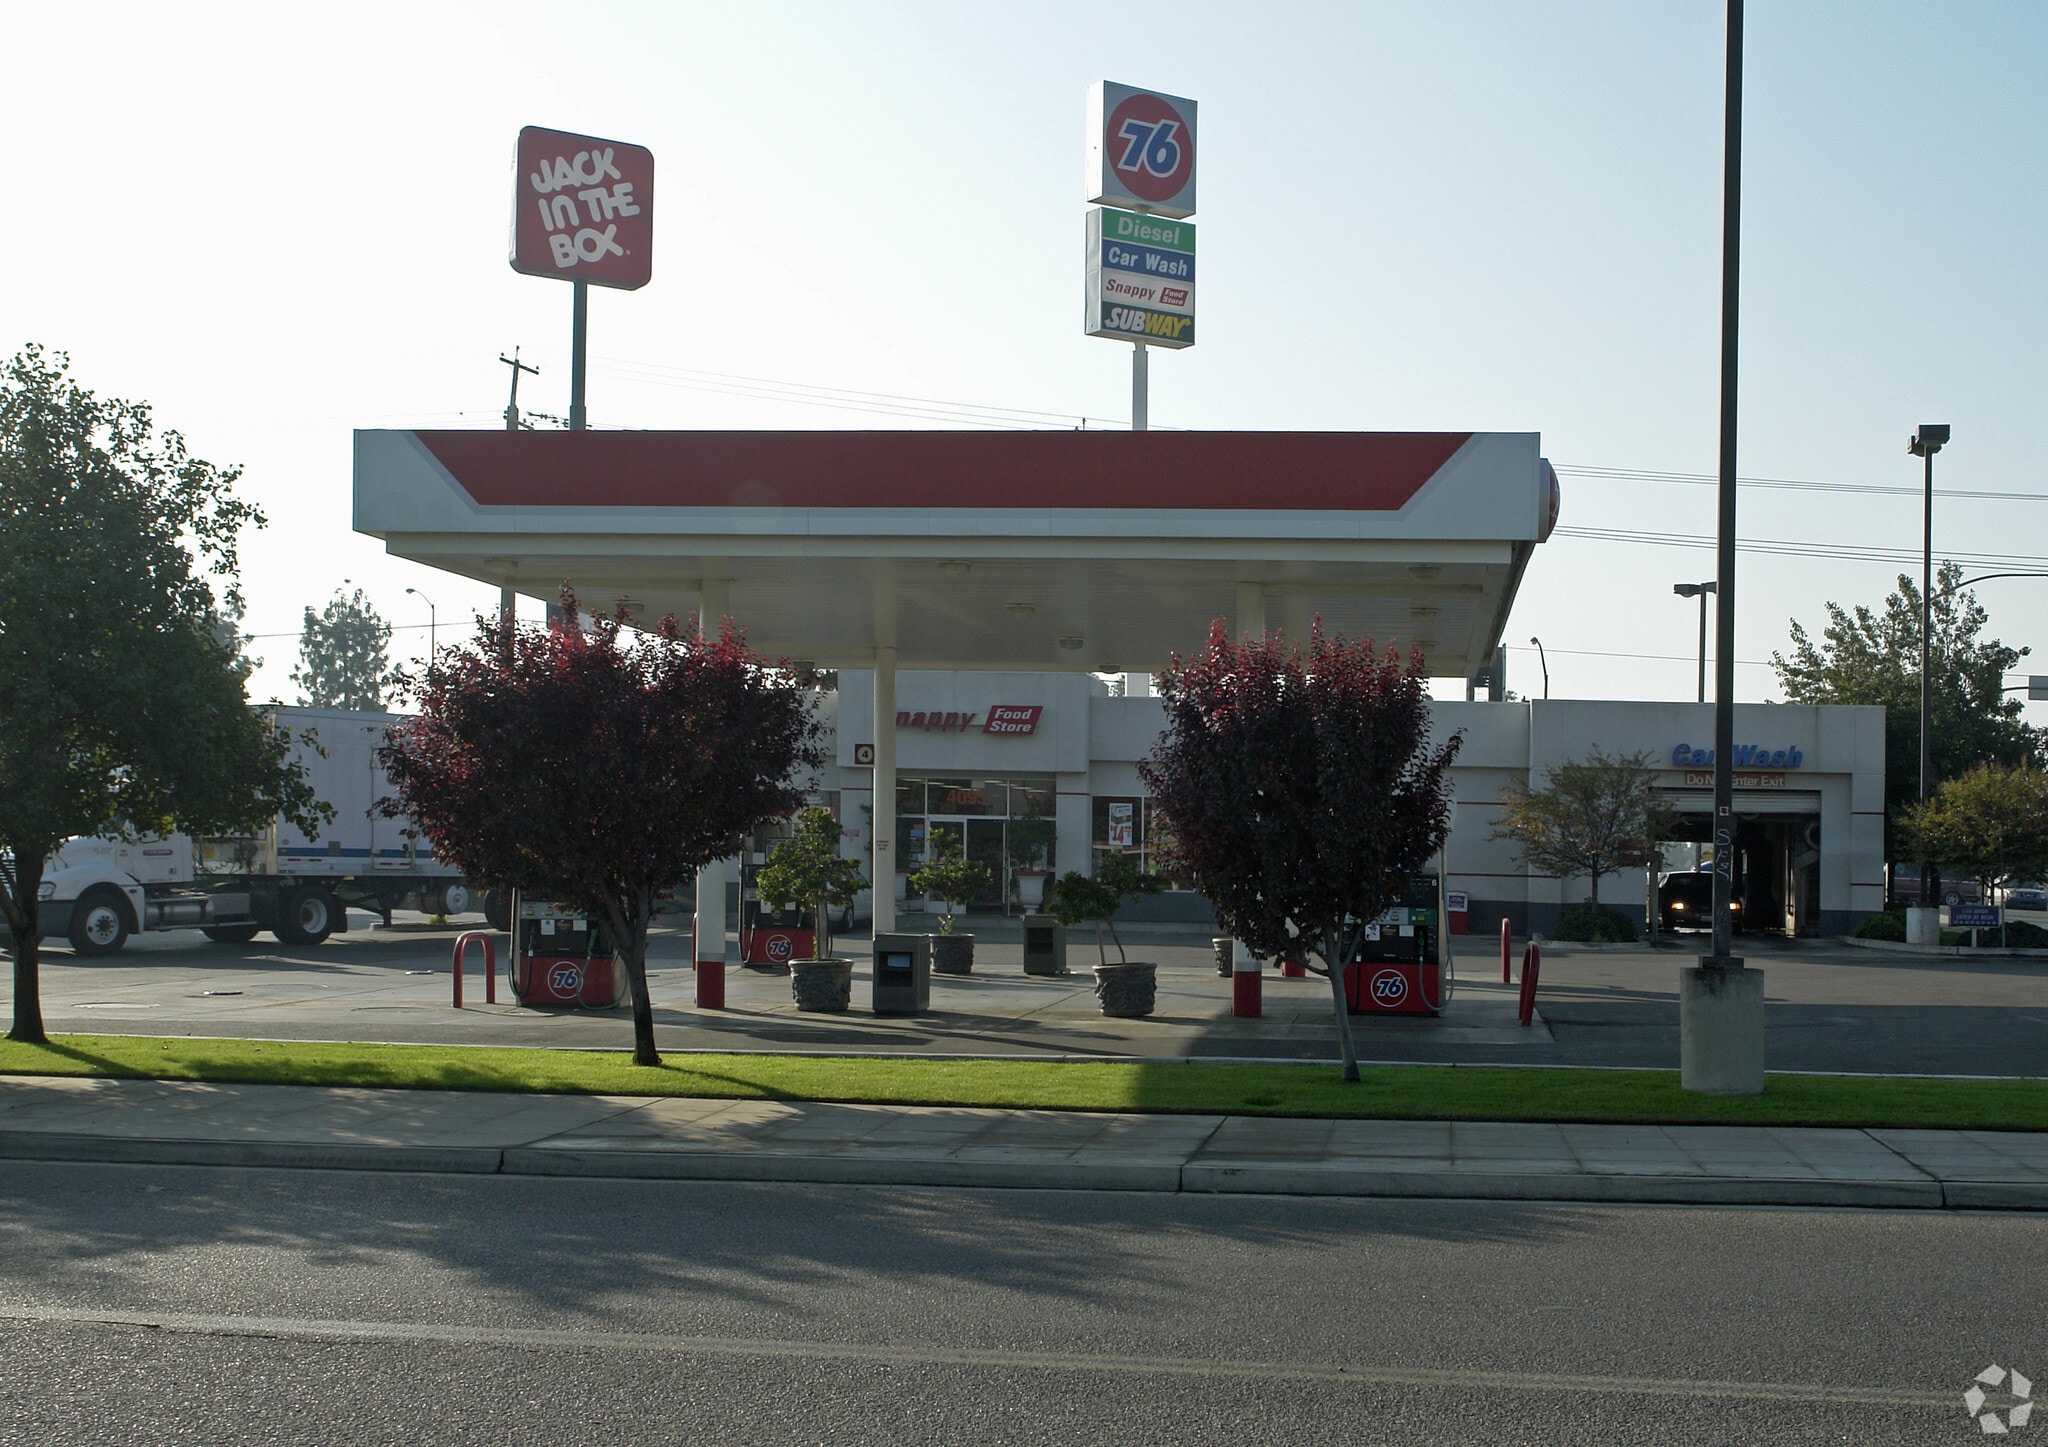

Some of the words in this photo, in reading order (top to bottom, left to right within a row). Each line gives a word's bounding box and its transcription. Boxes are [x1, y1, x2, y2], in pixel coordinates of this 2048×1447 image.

[1117, 118, 1180, 178] 76
[530, 147, 621, 193] JACK
[578, 182, 640, 222] THE
[1117, 216, 1180, 245] Diesel
[549, 223, 624, 268] BOX
[1108, 246, 1138, 267] Car
[1145, 252, 1188, 277] Wash
[1105, 278, 1156, 301] Snappy
[1164, 288, 1184, 299] Food
[1162, 296, 1184, 306] Store
[1104, 307, 1192, 338] SUBWAY
[896, 711, 978, 732] nappy
[994, 708, 1033, 720] Food
[989, 720, 1032, 732] Store
[861, 750, 869, 758] 4
[1732, 744, 1803, 769] Wash
[1686, 774, 1704, 785] Do
[1761, 775, 1784, 787] Exit
[1431, 879, 1438, 887] 6
[770, 941, 789, 955] 76
[554, 969, 578, 989] 76
[1376, 977, 1402, 998] 76
